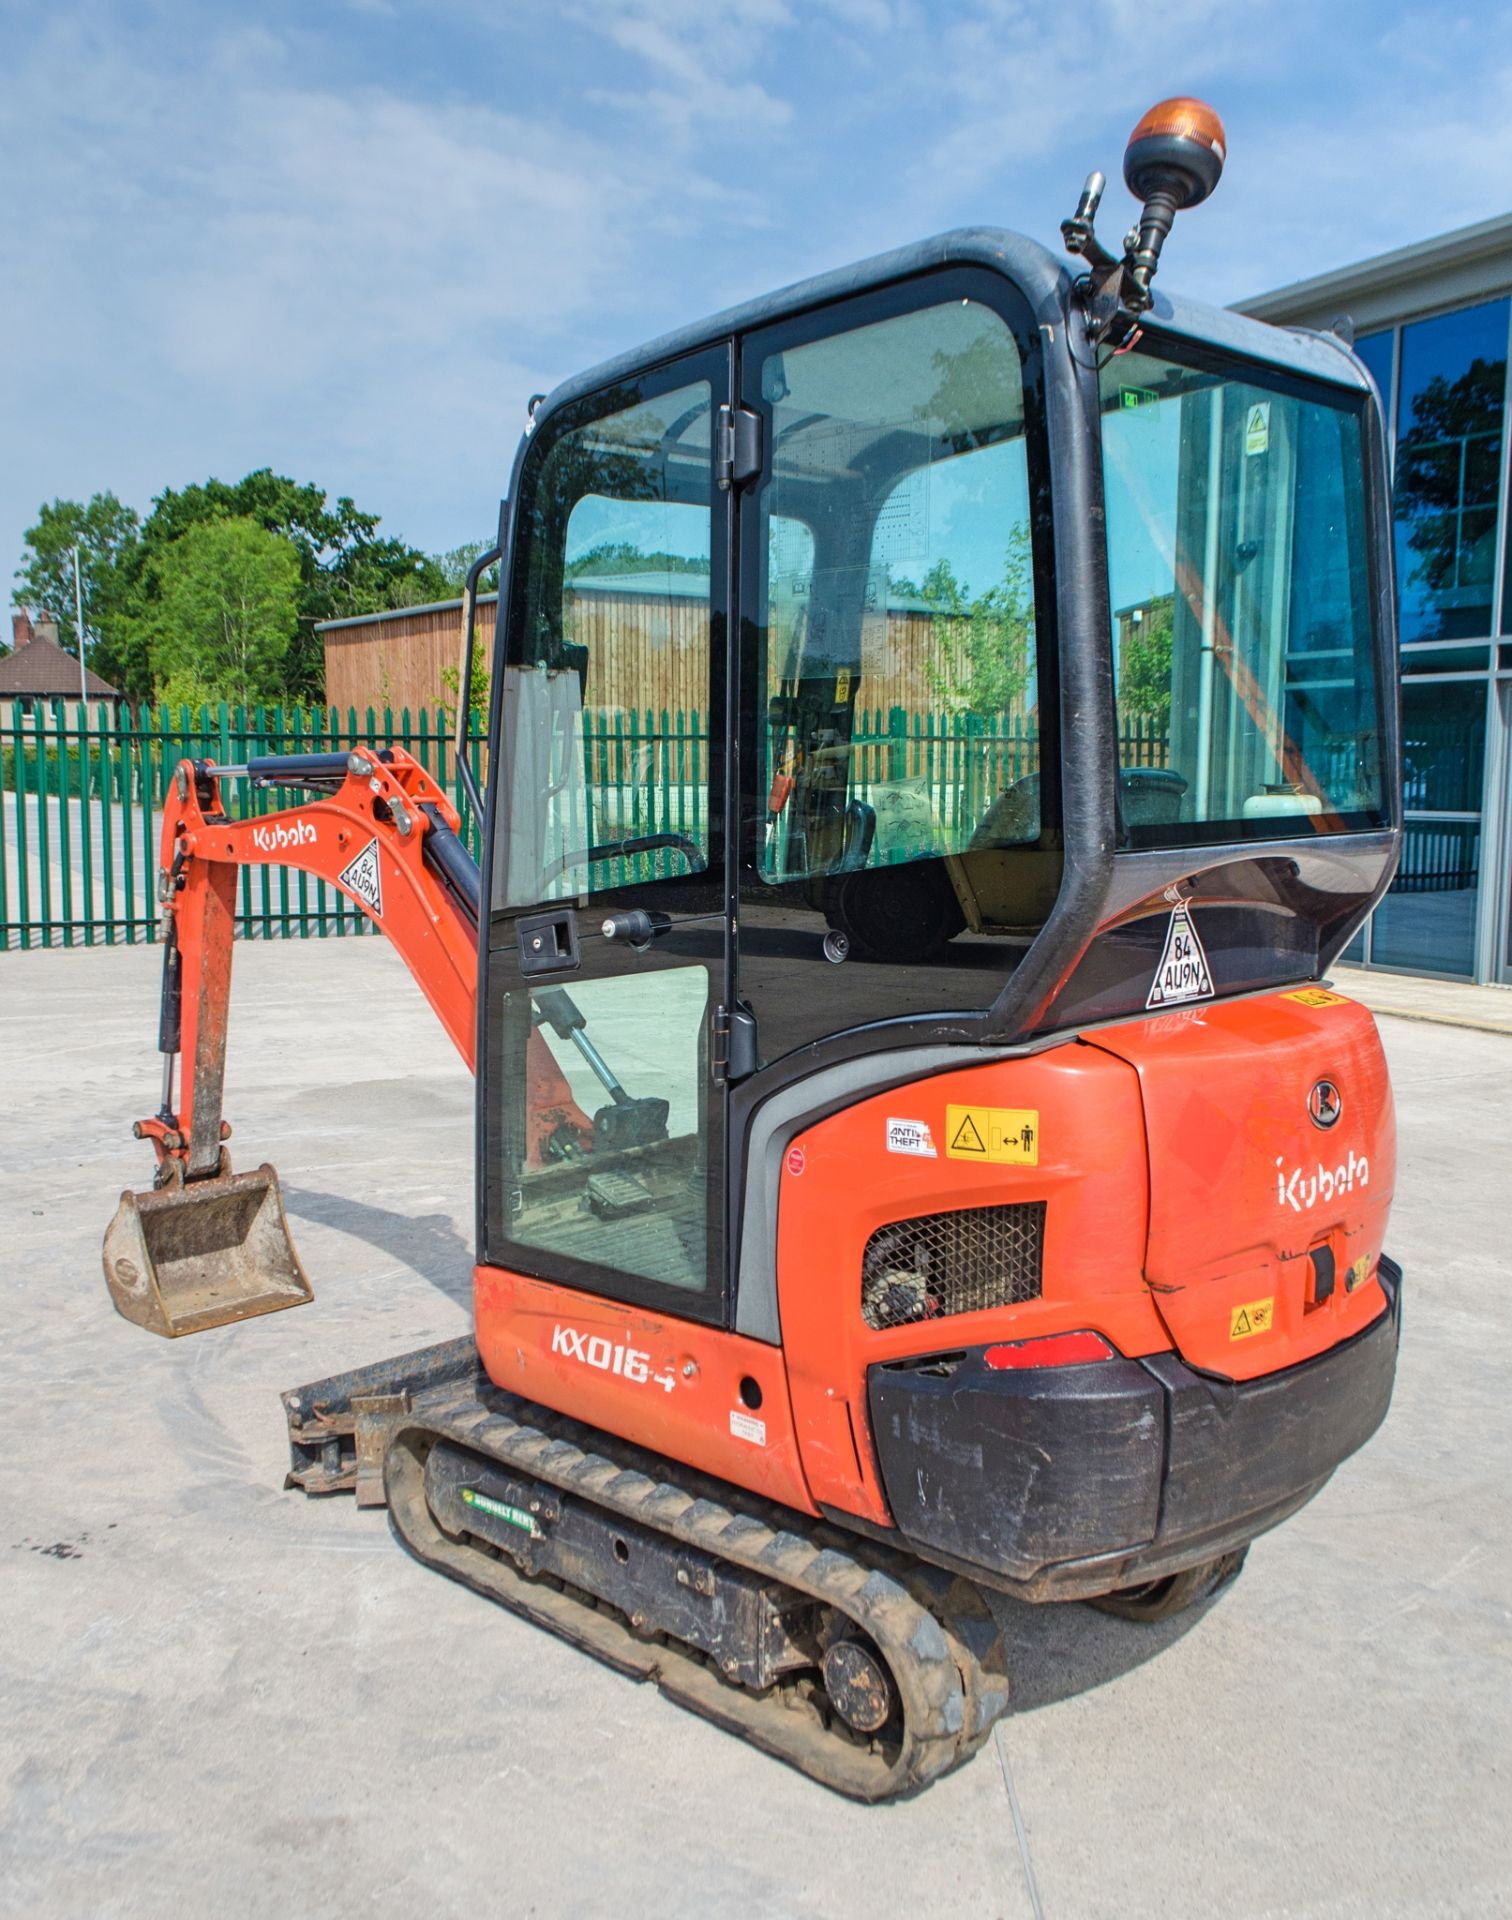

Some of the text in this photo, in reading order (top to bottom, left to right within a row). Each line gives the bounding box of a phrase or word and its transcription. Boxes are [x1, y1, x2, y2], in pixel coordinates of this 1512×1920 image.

[252, 819, 317, 852] Kubota
[360, 859, 374, 878] 84
[351, 869, 377, 901] AU9N
[1174, 934, 1192, 961] 84
[1164, 961, 1201, 992] AU9N
[889, 1126, 915, 1138] ANTI
[889, 1135, 921, 1148] THEFT
[1278, 1150, 1369, 1213] Kubota
